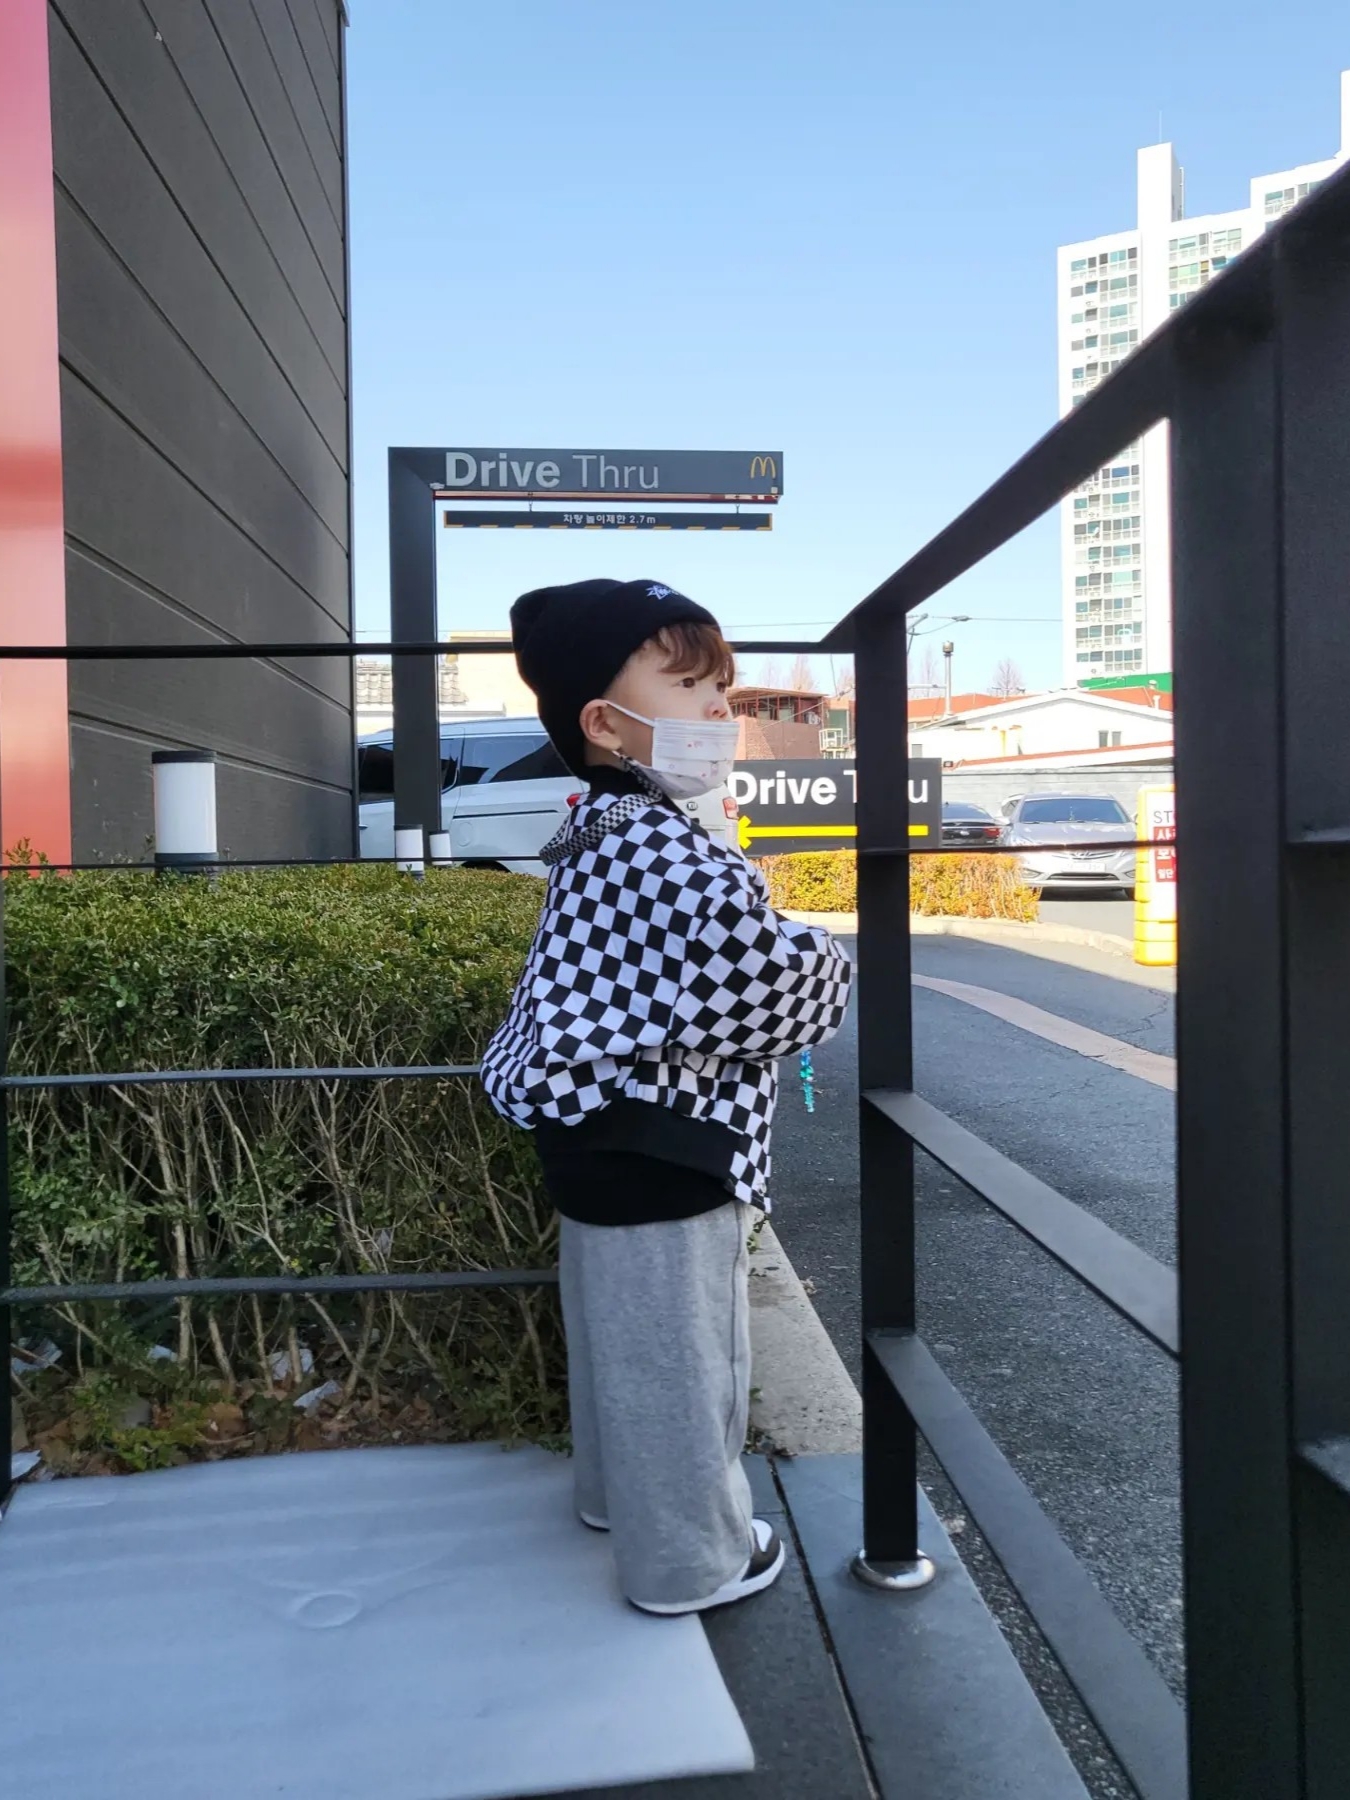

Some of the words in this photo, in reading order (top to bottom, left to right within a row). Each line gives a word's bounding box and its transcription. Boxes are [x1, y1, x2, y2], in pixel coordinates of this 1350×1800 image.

[445, 452, 560, 487] Drive
[572, 454, 659, 489] Thru
[563, 513, 583, 524] 차량
[727, 770, 837, 805] Drive
[843, 770, 928, 803] Tu
[1153, 810, 1173, 824] ST
